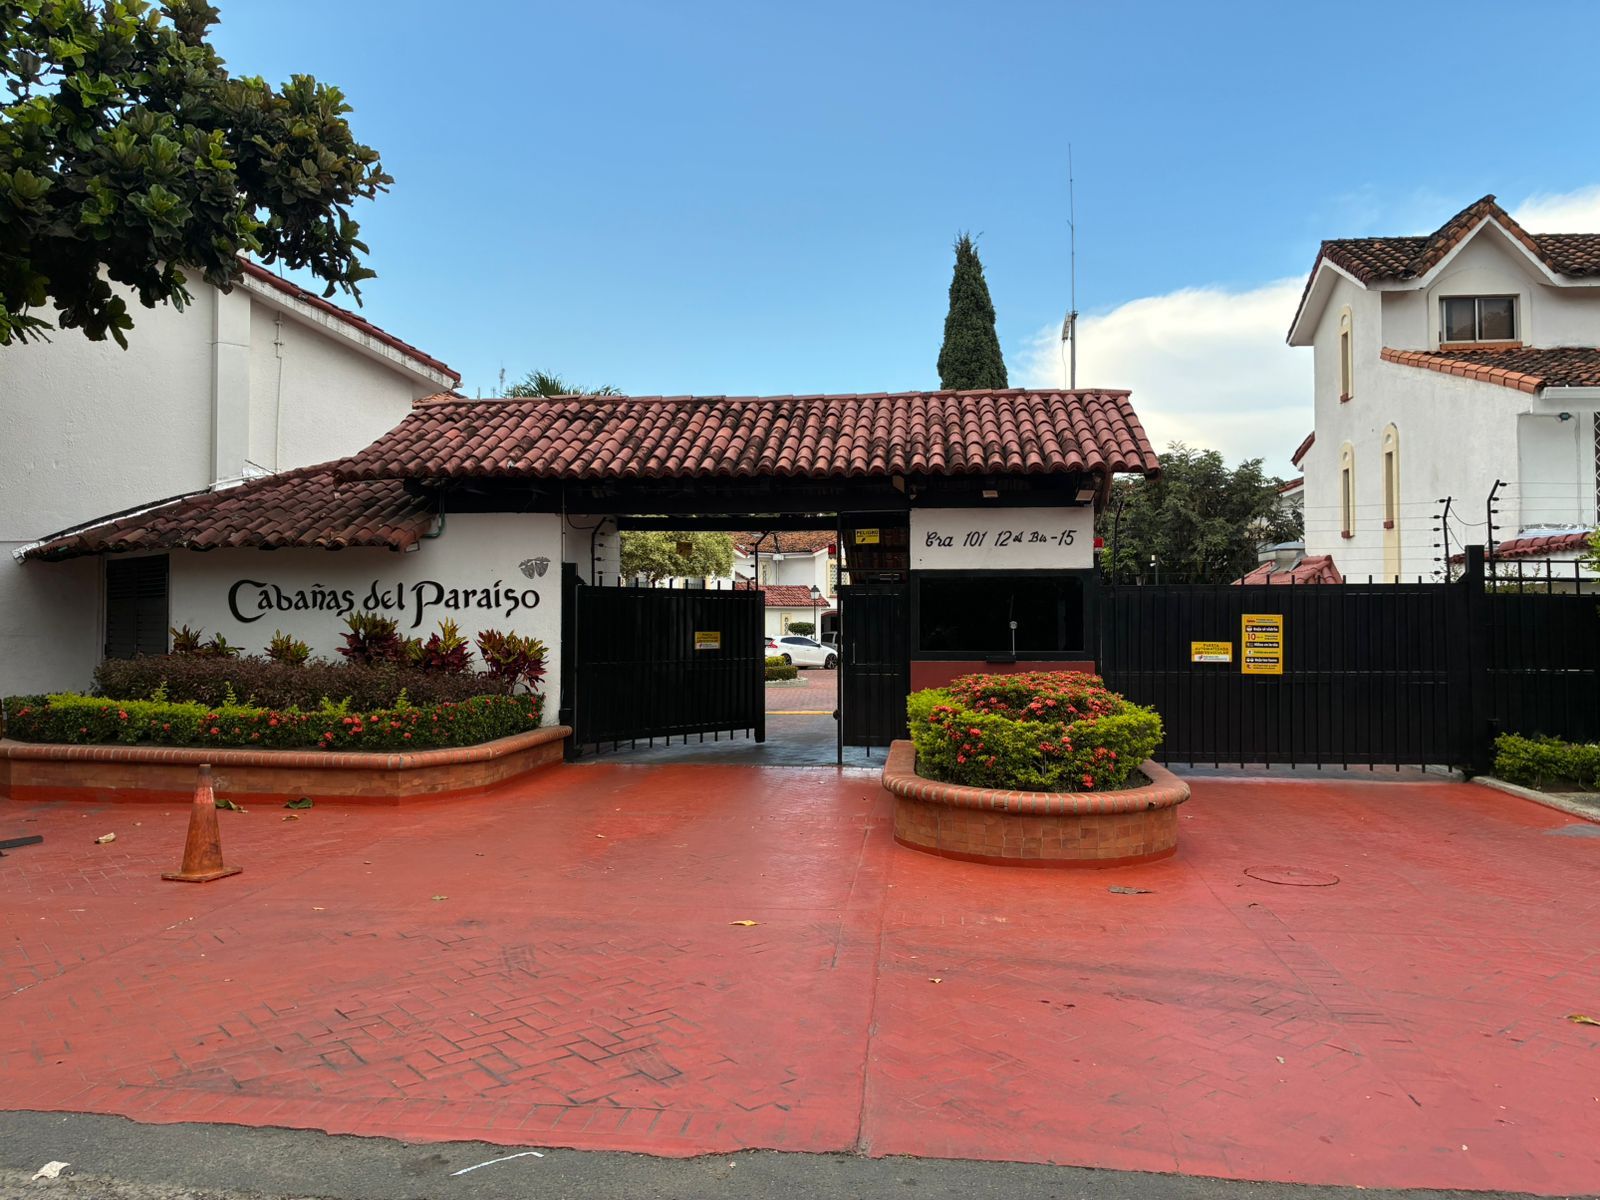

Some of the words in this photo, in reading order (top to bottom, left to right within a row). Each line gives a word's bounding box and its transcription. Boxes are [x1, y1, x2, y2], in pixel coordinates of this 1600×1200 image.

[925, 531, 954, 547] Cra
[963, 531, 988, 547] 101
[228, 579, 355, 624] Cabañas
[363, 579, 405, 611] del
[410, 580, 540, 628] Paraíso
